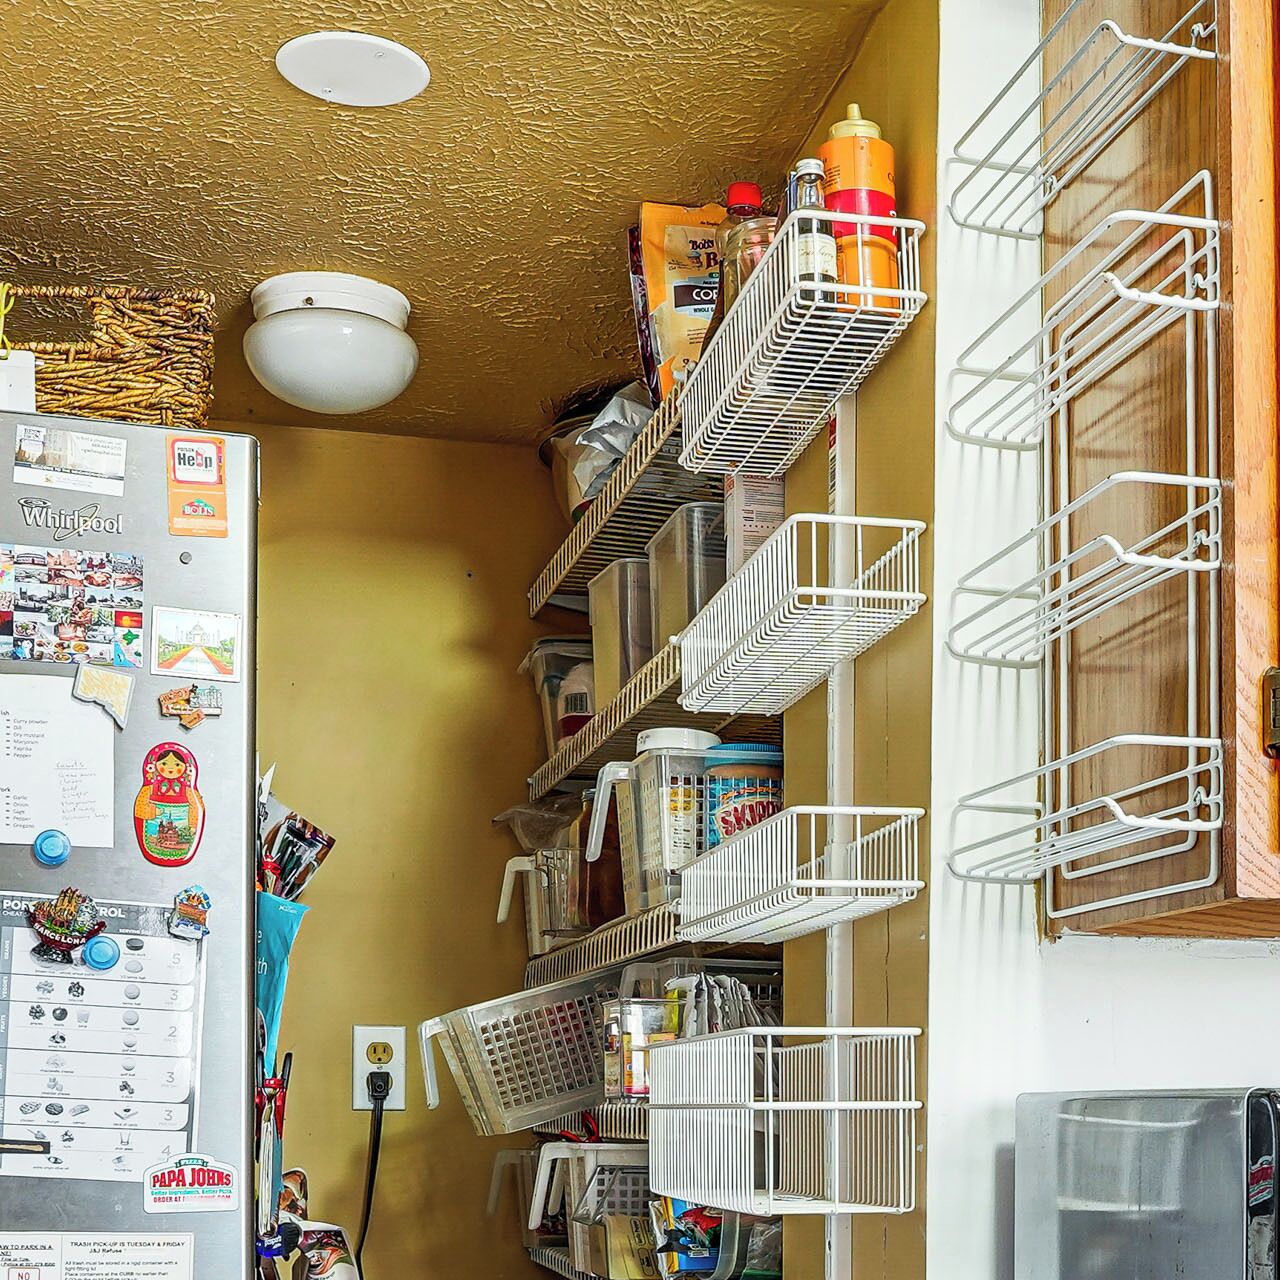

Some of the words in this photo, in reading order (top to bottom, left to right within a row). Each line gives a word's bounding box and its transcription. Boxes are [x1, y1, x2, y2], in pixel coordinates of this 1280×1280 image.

[23, 505, 122, 534] Whirlpool
[34, 923, 86, 945] BARCELONA
[172, 953, 180, 965] 5
[171, 990, 178, 1000] 3
[167, 1026, 176, 1037] 2
[166, 1072, 175, 1083] 3
[164, 1110, 173, 1121] 3
[153, 1169, 186, 1187] PAPA
[189, 1168, 231, 1187] JOHNS
[18, 1272, 30, 1280] NO
